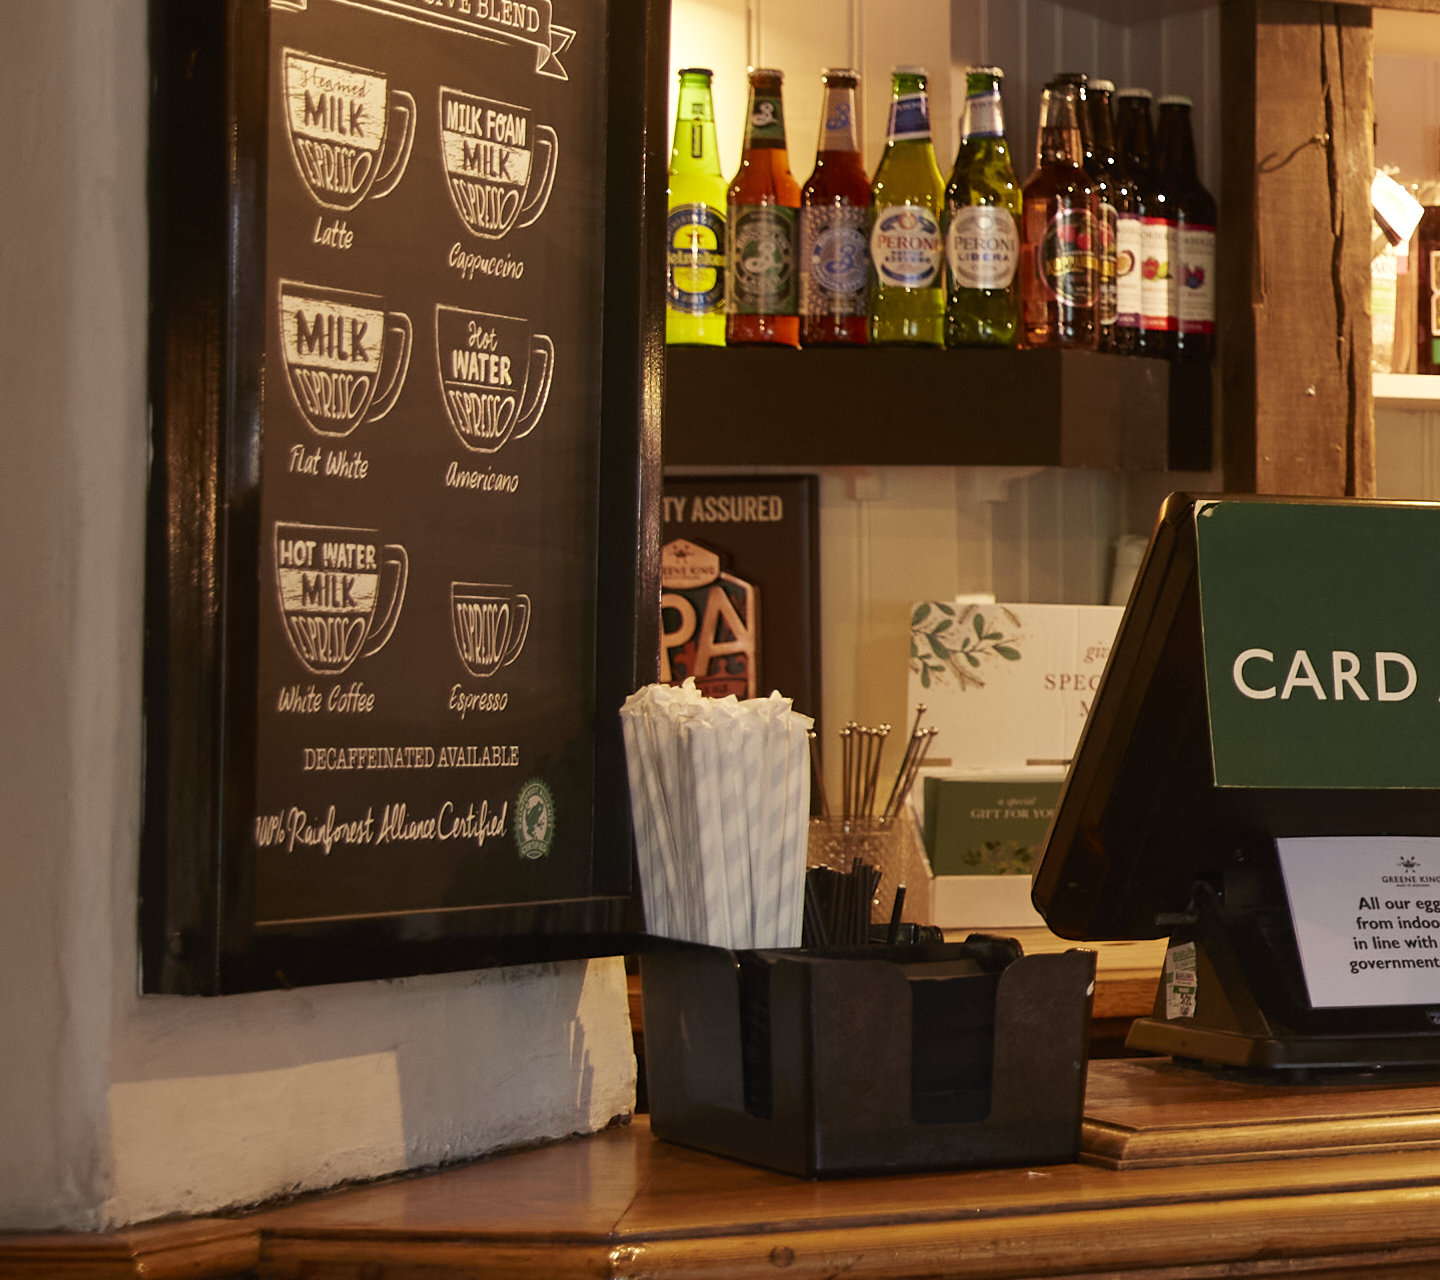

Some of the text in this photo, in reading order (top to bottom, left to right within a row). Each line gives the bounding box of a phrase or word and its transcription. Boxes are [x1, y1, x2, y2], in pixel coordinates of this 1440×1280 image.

[304, 89, 365, 139] MILK
[446, 100, 527, 147] MILK FOAM
[463, 139, 510, 180] MILK
[313, 216, 354, 250] Latte
[449, 241, 524, 281] Cappuccino
[296, 309, 369, 363] MILK
[452, 348, 512, 387] WATER
[290, 443, 369, 480] Flat White
[445, 461, 519, 494] Americano
[691, 495, 784, 523] ASSURED
[280, 539, 377, 571] HOT WATER
[301, 572, 358, 608] MILK
[660, 586, 756, 683] PA
[1232, 648, 1419, 704] CARD
[277, 682, 376, 713] White Coffee
[449, 683, 509, 721] Espresso
[303, 745, 520, 771] DECAFFEINATED AVAILABLE
[287, 804, 376, 855] Rainforest
[376, 802, 437, 846] Alliance
[437, 800, 509, 848] Certified
[1381, 875, 1418, 885] GREENE
[1358, 896, 1381, 911] All
[1385, 899, 1412, 911] our
[1355, 916, 1395, 931] from
[1353, 936, 1369, 951] in
[1372, 935, 1402, 950] line
[1404, 934, 1439, 950] with
